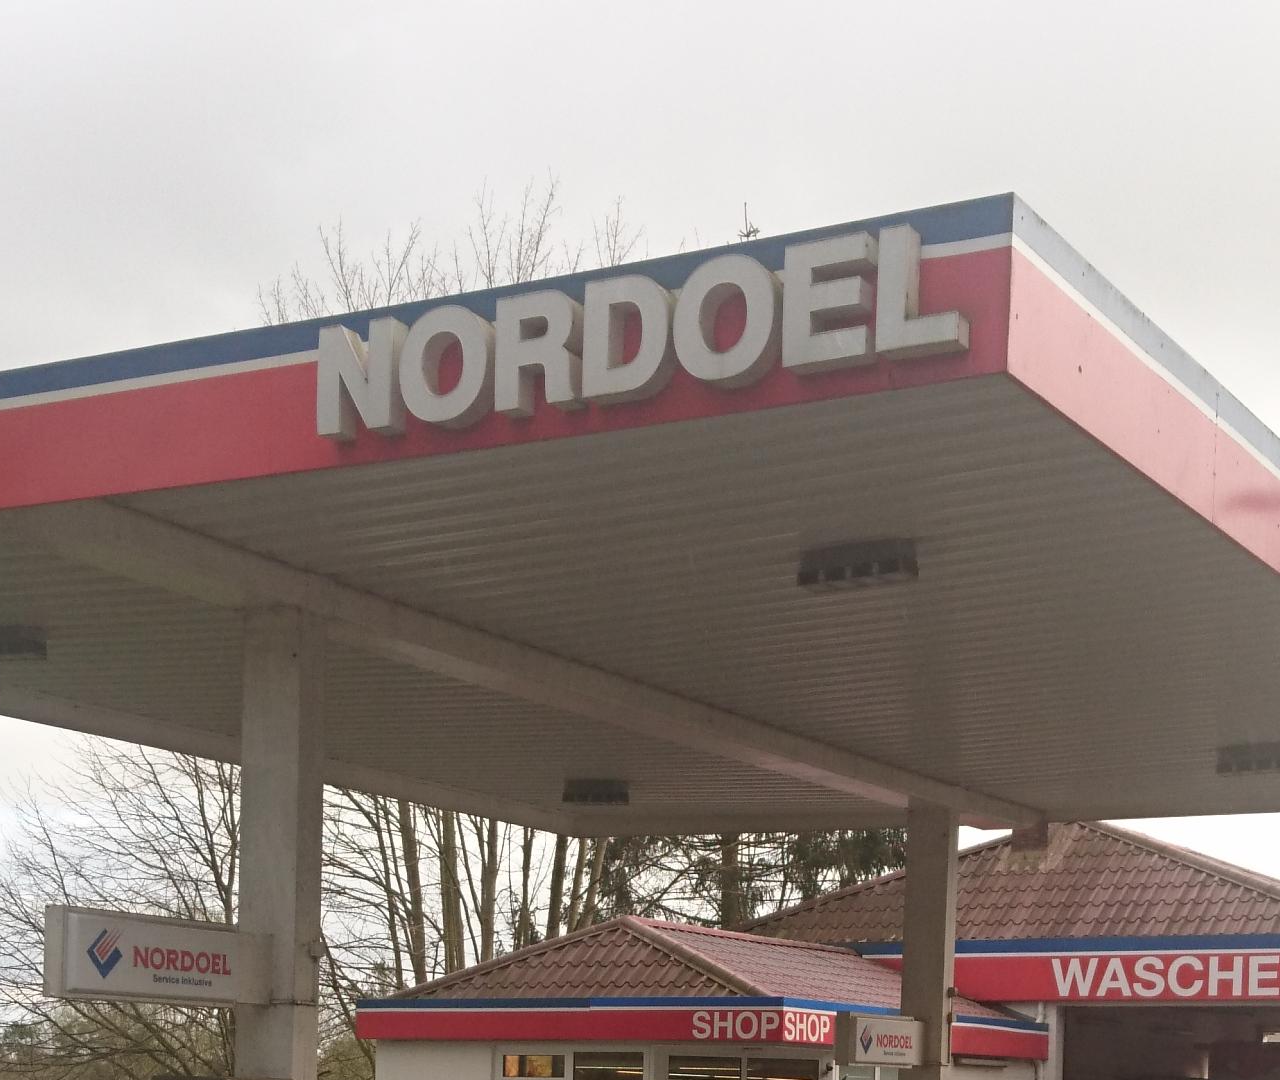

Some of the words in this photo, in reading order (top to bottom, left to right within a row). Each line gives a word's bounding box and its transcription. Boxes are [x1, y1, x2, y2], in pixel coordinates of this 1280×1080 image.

[317, 223, 970, 441] NORDOEL
[133, 945, 232, 976] NORDOEL
[152, 973, 180, 985] Service
[692, 1010, 779, 1041] SHOP
[784, 1013, 831, 1042] SHOP
[876, 1033, 913, 1049] NORDOEL
